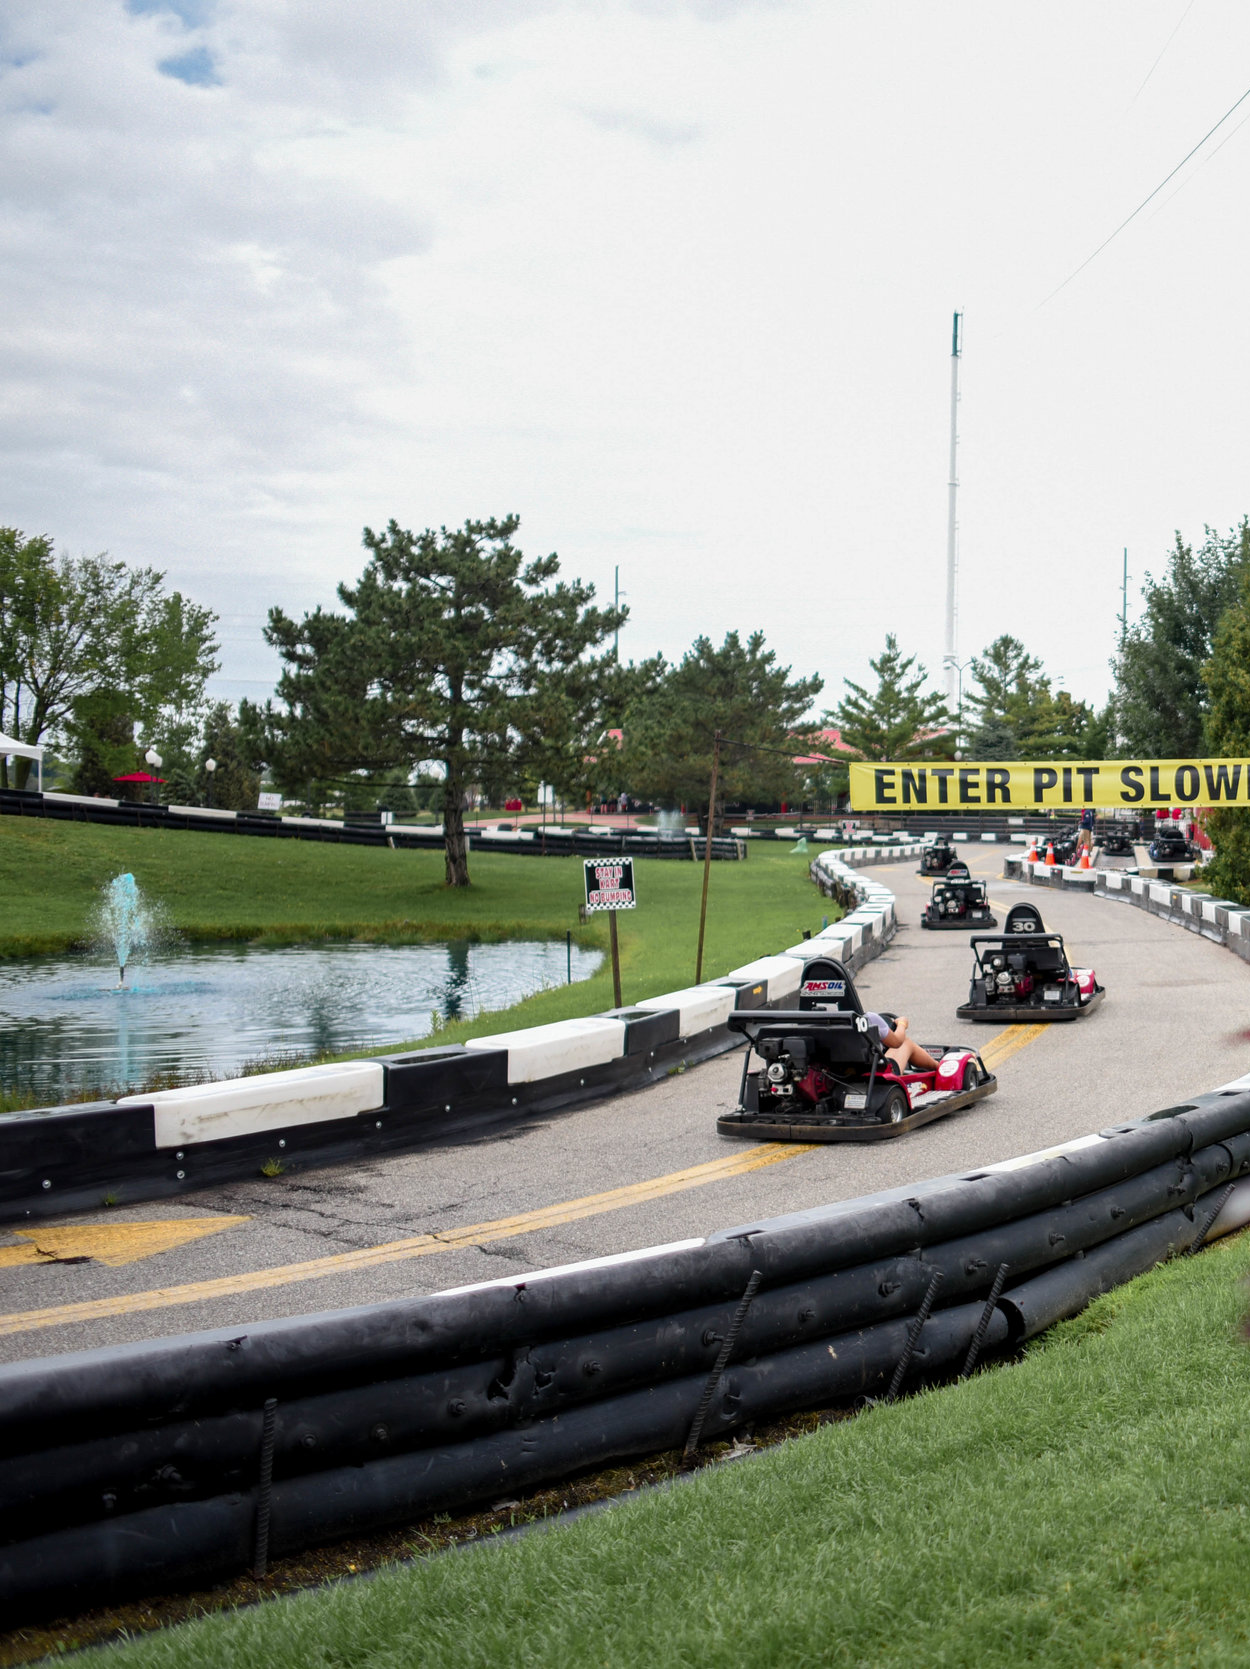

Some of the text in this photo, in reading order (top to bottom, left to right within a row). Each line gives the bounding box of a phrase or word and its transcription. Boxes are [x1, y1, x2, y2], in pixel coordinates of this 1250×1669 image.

[874, 768, 1012, 804] ENTER
[1033, 766, 1100, 803] PIT
[596, 866, 623, 879] STAY IN
[599, 878, 620, 889] KART
[590, 890, 632, 903] NO BUMPING
[1012, 921, 1036, 932] 30
[804, 981, 844, 991] AMSOIL
[855, 1017, 868, 1033] 10
